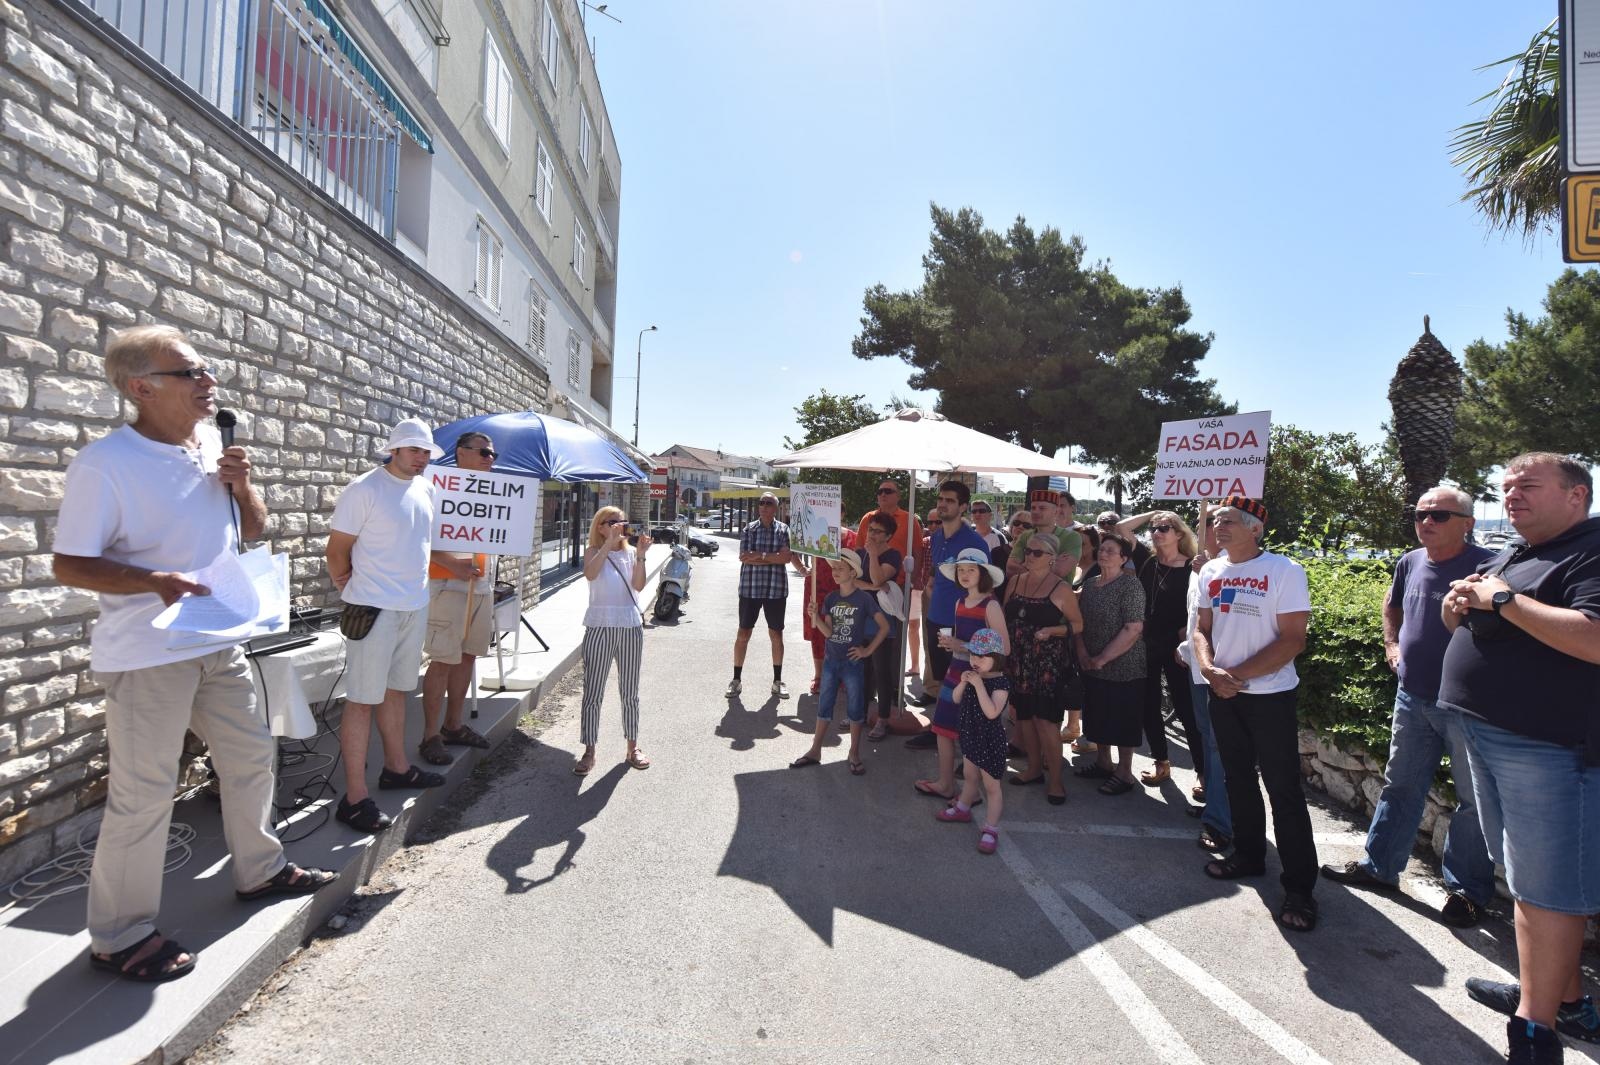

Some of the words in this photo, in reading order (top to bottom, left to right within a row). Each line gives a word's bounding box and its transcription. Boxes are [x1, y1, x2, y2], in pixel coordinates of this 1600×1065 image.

[1198, 419, 1224, 429] VAŠA
[1165, 430, 1259, 453] FASADA
[1157, 461, 1175, 470] NIJE
[1176, 459, 1215, 469] VAŽNIJA
[1216, 458, 1232, 467] OD
[1233, 455, 1266, 466] NAŠIH
[432, 474, 460, 491] NE
[464, 473, 525, 499] ŽELIM
[1165, 475, 1246, 496] ŽIVOTA
[441, 499, 511, 520] DOBITI
[440, 523, 484, 542] RAK
[489, 528, 507, 544] !!!
[1223, 575, 1268, 592] narod
